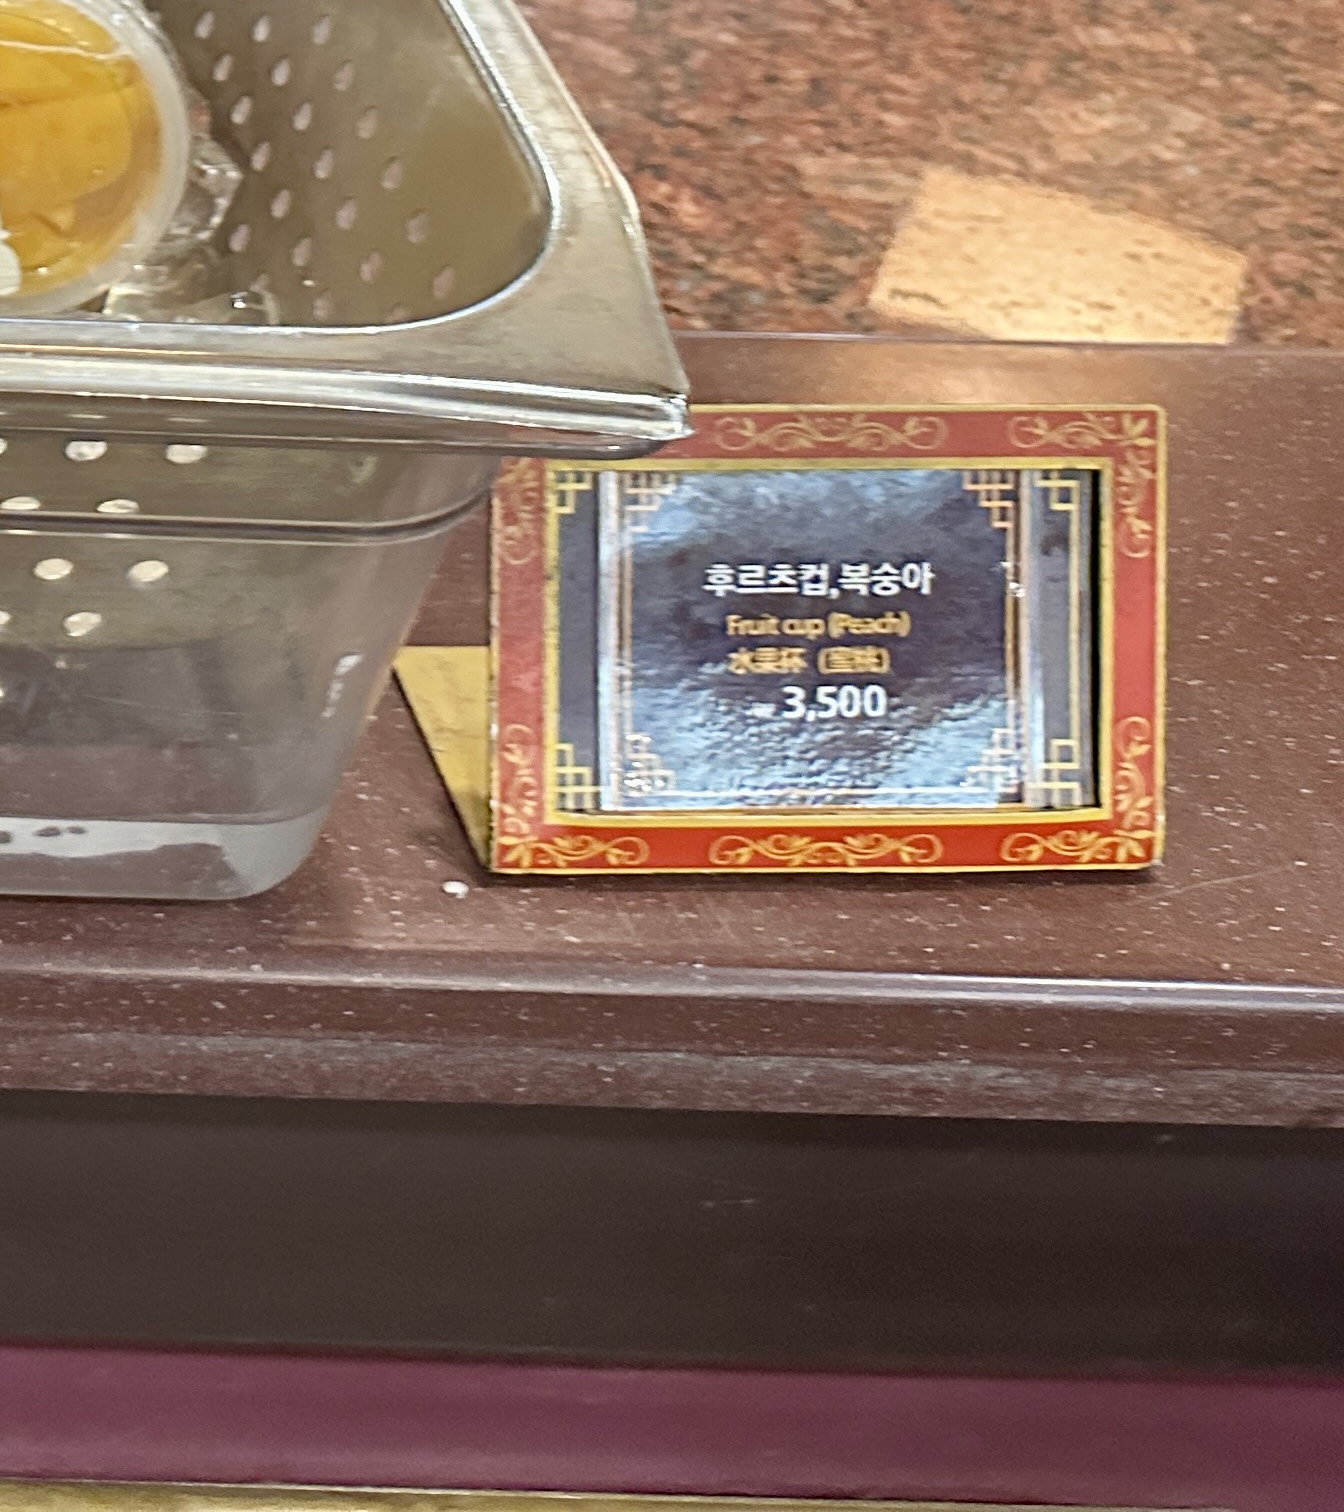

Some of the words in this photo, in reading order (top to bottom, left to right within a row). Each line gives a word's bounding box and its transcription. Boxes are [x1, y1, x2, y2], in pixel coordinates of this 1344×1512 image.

[702, 561, 935, 599] 후르츠컵,복숭아
[725, 613, 780, 636] Fruit
[782, 618, 826, 640] cup
[827, 610, 910, 638] (Peach)
